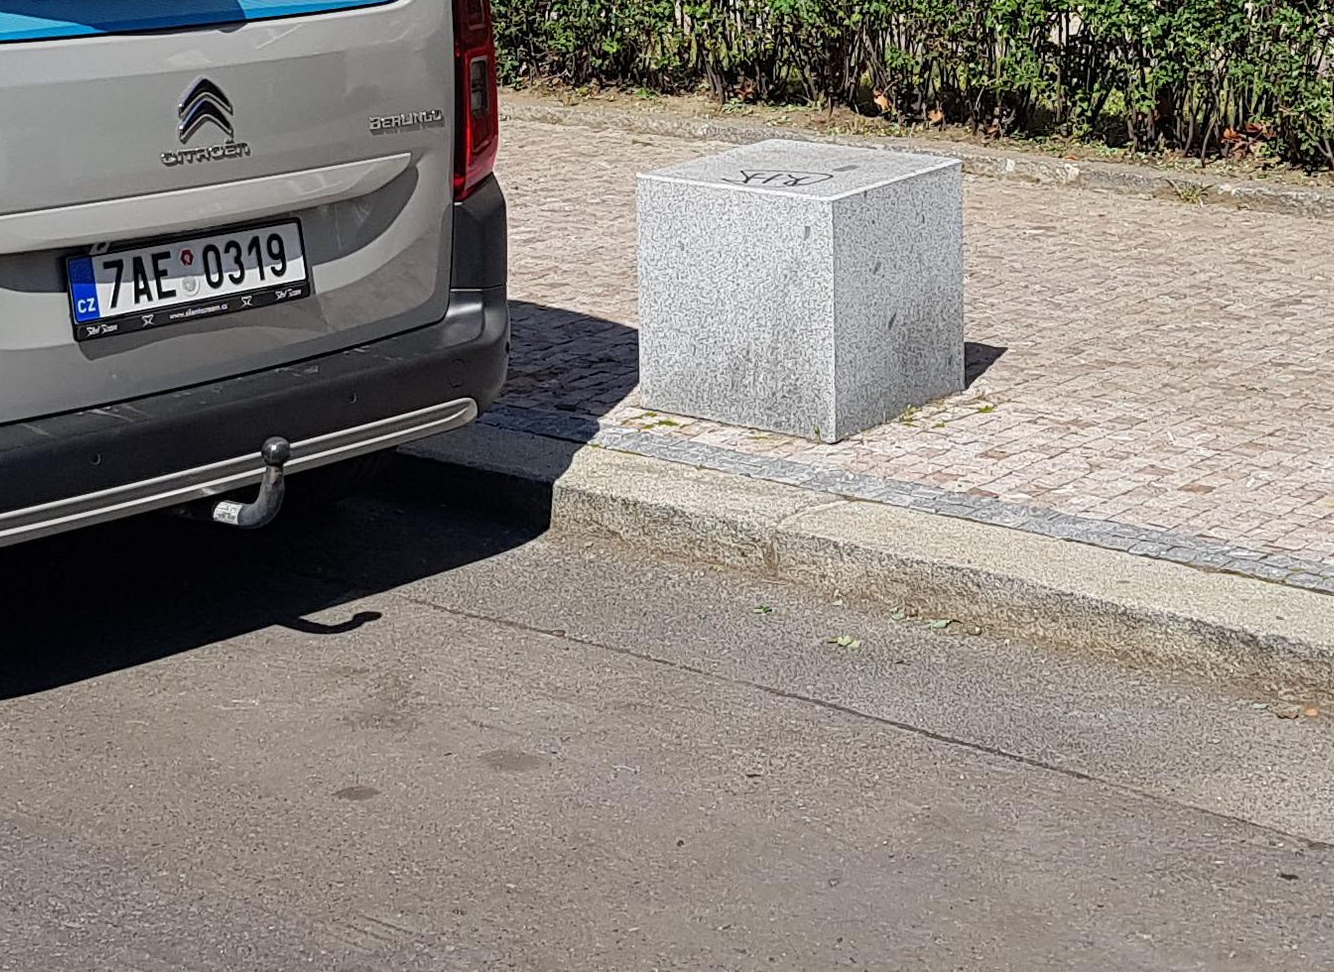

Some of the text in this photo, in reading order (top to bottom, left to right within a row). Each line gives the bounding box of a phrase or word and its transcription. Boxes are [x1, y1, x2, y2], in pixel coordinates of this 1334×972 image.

[161, 140, 250, 167] CITROËN
[77, 233, 287, 313] CZ 7AE 0319
